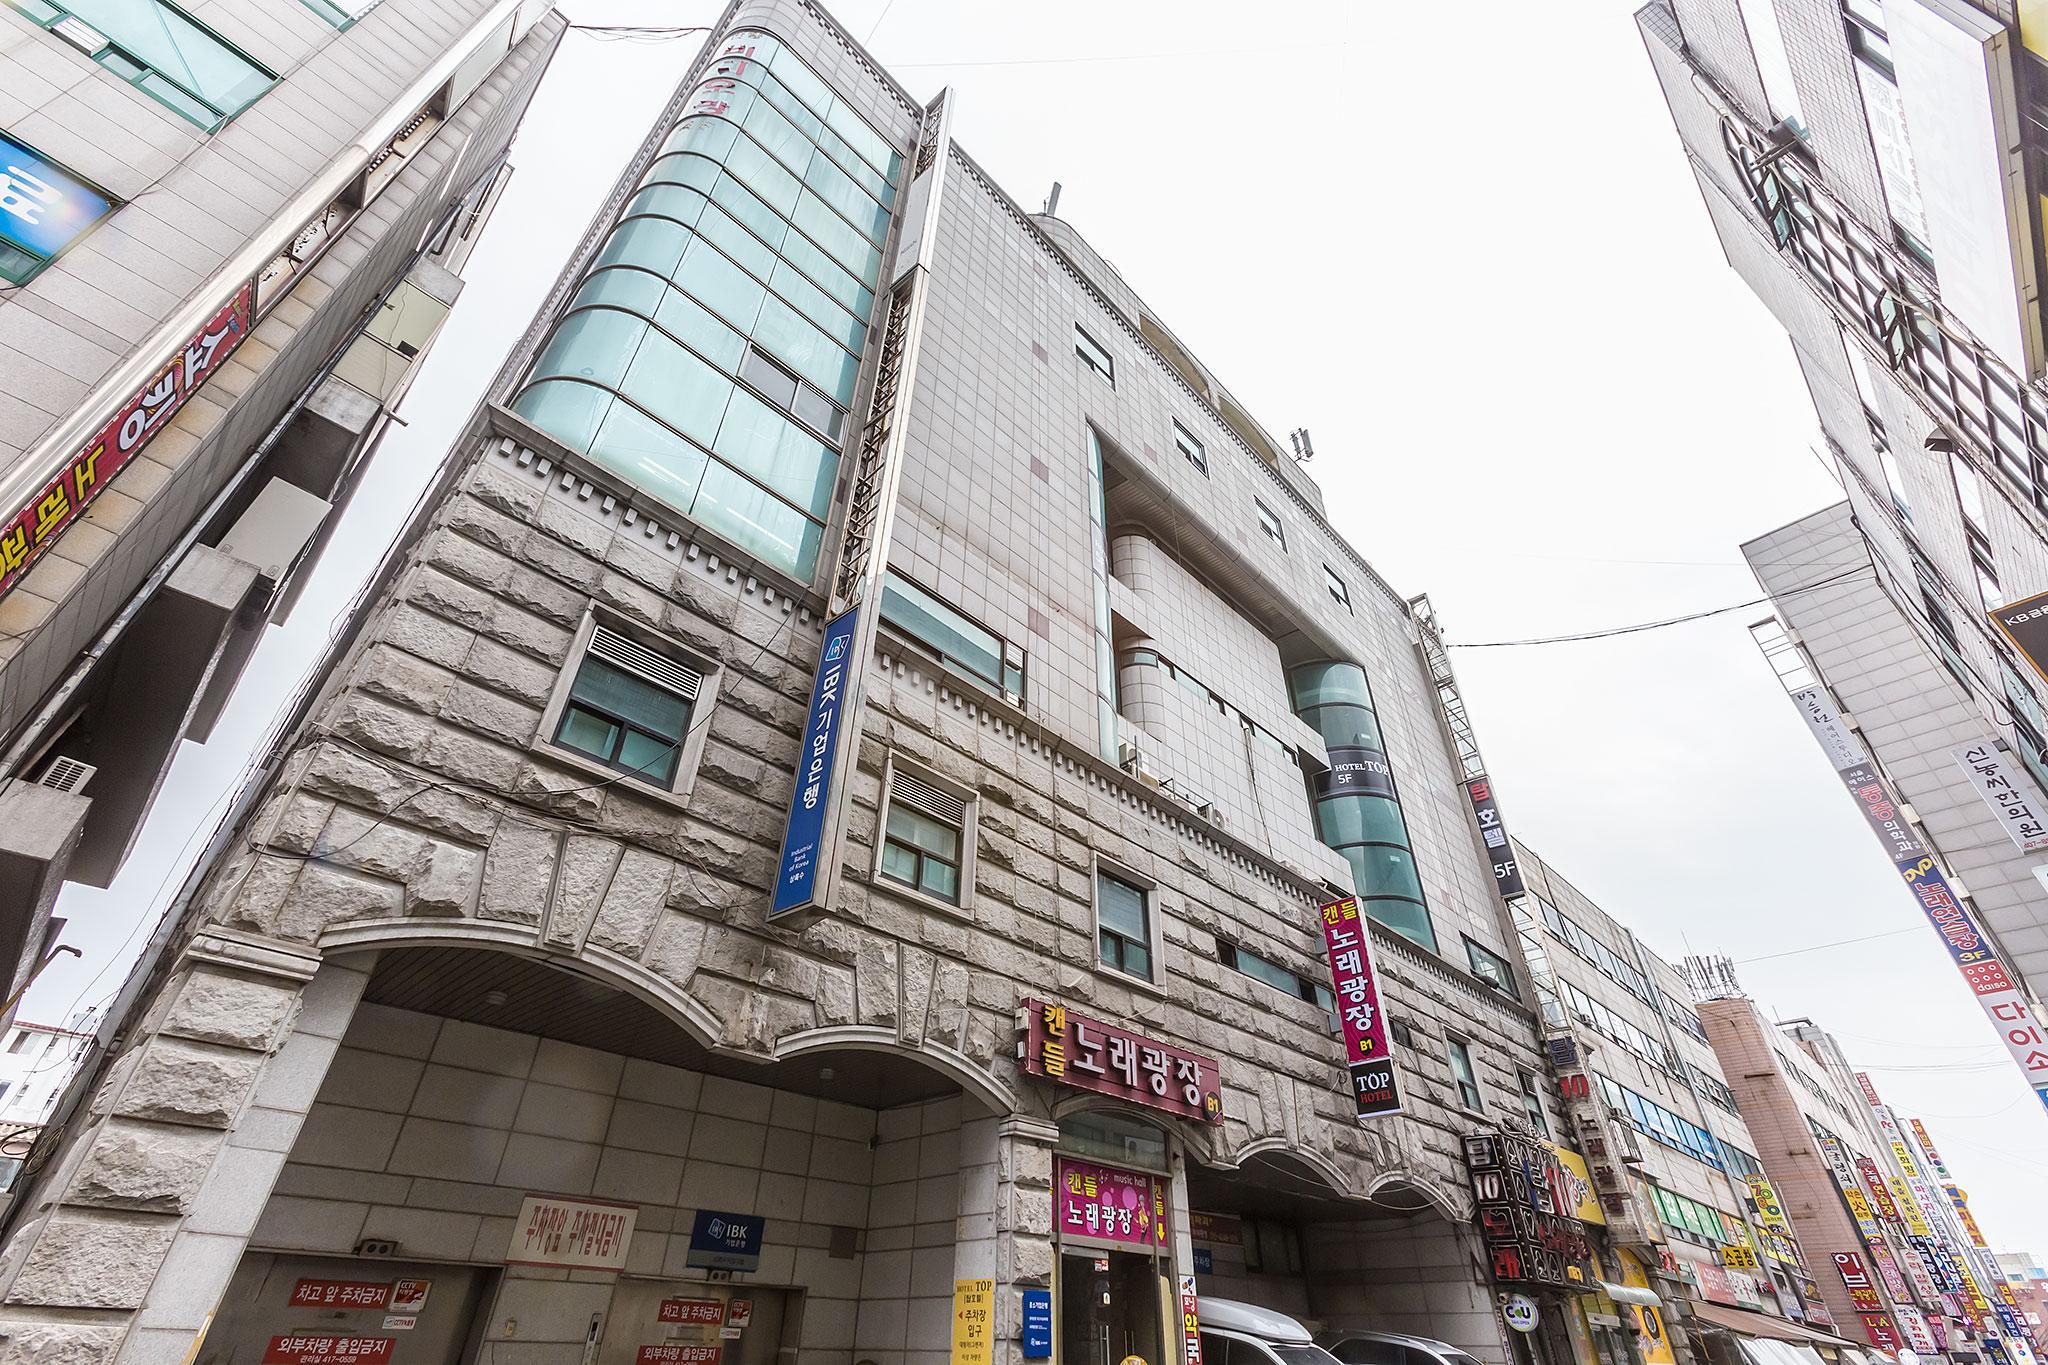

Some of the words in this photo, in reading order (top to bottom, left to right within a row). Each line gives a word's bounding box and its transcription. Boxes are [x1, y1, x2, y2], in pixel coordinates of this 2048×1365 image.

[119, 325, 229, 451] 쇼킹
[819, 663, 842, 709] IBK
[803, 708, 833, 811] 기업은행
[1335, 763, 1365, 772] HOTEL
[1364, 760, 1389, 776] TOP
[1337, 773, 1352, 784] 5F
[1493, 860, 1516, 879] 5F
[1903, 857, 1933, 883] DVD
[1323, 900, 1357, 925] 캔들
[1959, 950, 1986, 962] 3F
[1330, 927, 1376, 1032] 노래광장
[1977, 981, 2008, 992] daiso
[1359, 1038, 1373, 1051] B1
[1991, 1001, 2048, 1072] 다이소
[1041, 1003, 1066, 1079] 캔들
[1073, 1021, 1204, 1107] 노래광장
[1206, 1097, 1220, 1113] B1
[1357, 1072, 1390, 1092] TOP
[1360, 1091, 1392, 1104] HOTEL
[1067, 1173, 1098, 1198] 캔들
[1113, 1174, 1133, 1186] music
[1134, 1176, 1147, 1188] hall
[1751, 1184, 1781, 1215] 7080
[1067, 1200, 1133, 1235] 노래광장
[727, 1224, 748, 1239] IBK
[1725, 1249, 1754, 1267] 소곱창
[297, 1284, 322, 1302] 차고
[324, 1286, 339, 1303] 앞
[340, 1286, 388, 1305] 주차금지
[975, 1280, 992, 1292] TOP
[662, 1304, 679, 1318] 차고
[681, 1305, 690, 1319] 앞
[691, 1306, 722, 1320] 주차금지
[965, 1309, 986, 1322] 주차장
[1505, 1305, 1531, 1319] CU
[967, 1324, 982, 1338] 입구
[1866, 1317, 1890, 1327] LA
[277, 1337, 333, 1355] 외부차량
[336, 1338, 388, 1355] 출입금지
[643, 1347, 680, 1361] 외부차량
[682, 1347, 717, 1361] 출입금지
